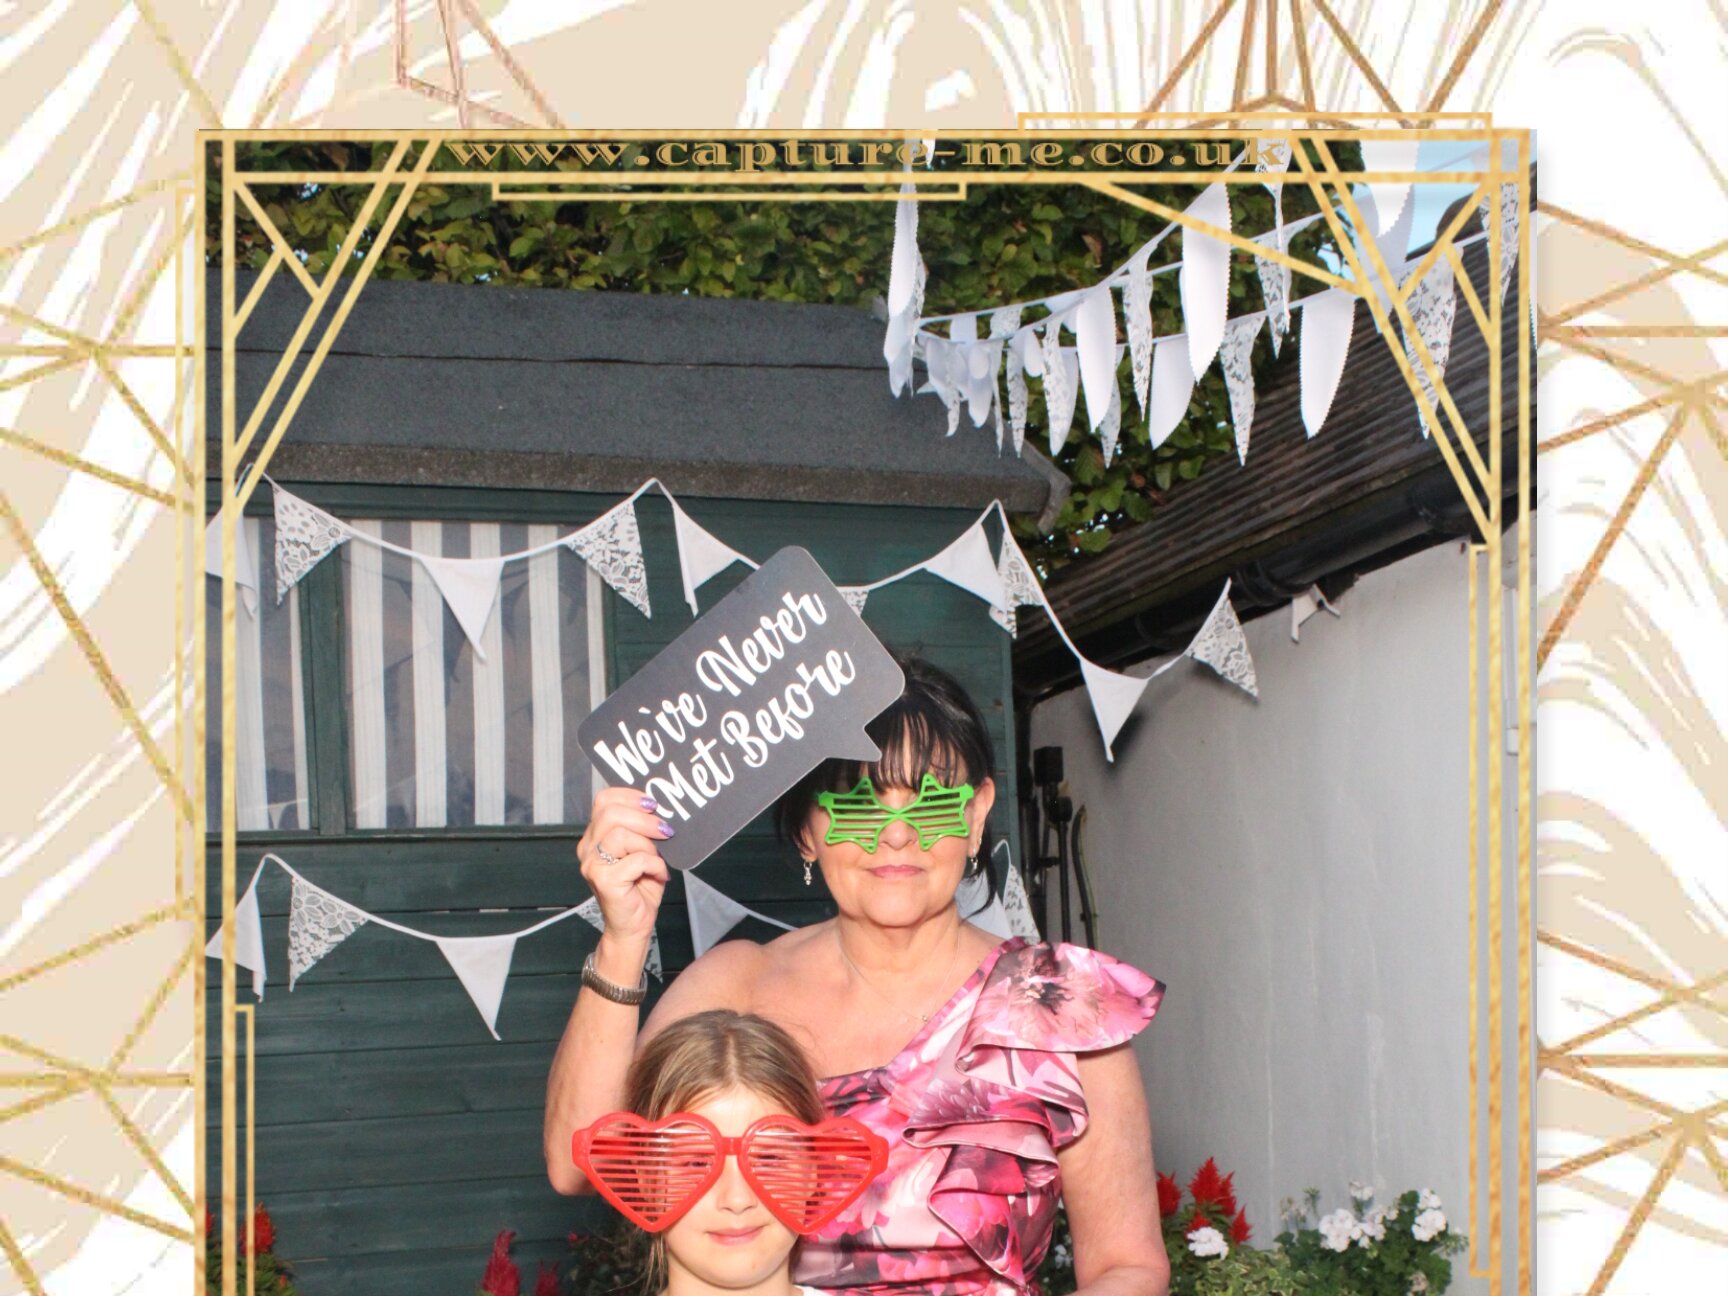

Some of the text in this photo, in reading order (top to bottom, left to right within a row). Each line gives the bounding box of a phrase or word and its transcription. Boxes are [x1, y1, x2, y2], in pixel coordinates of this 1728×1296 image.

[593, 591, 828, 785] We've Never
[645, 649, 857, 822] Met Before
